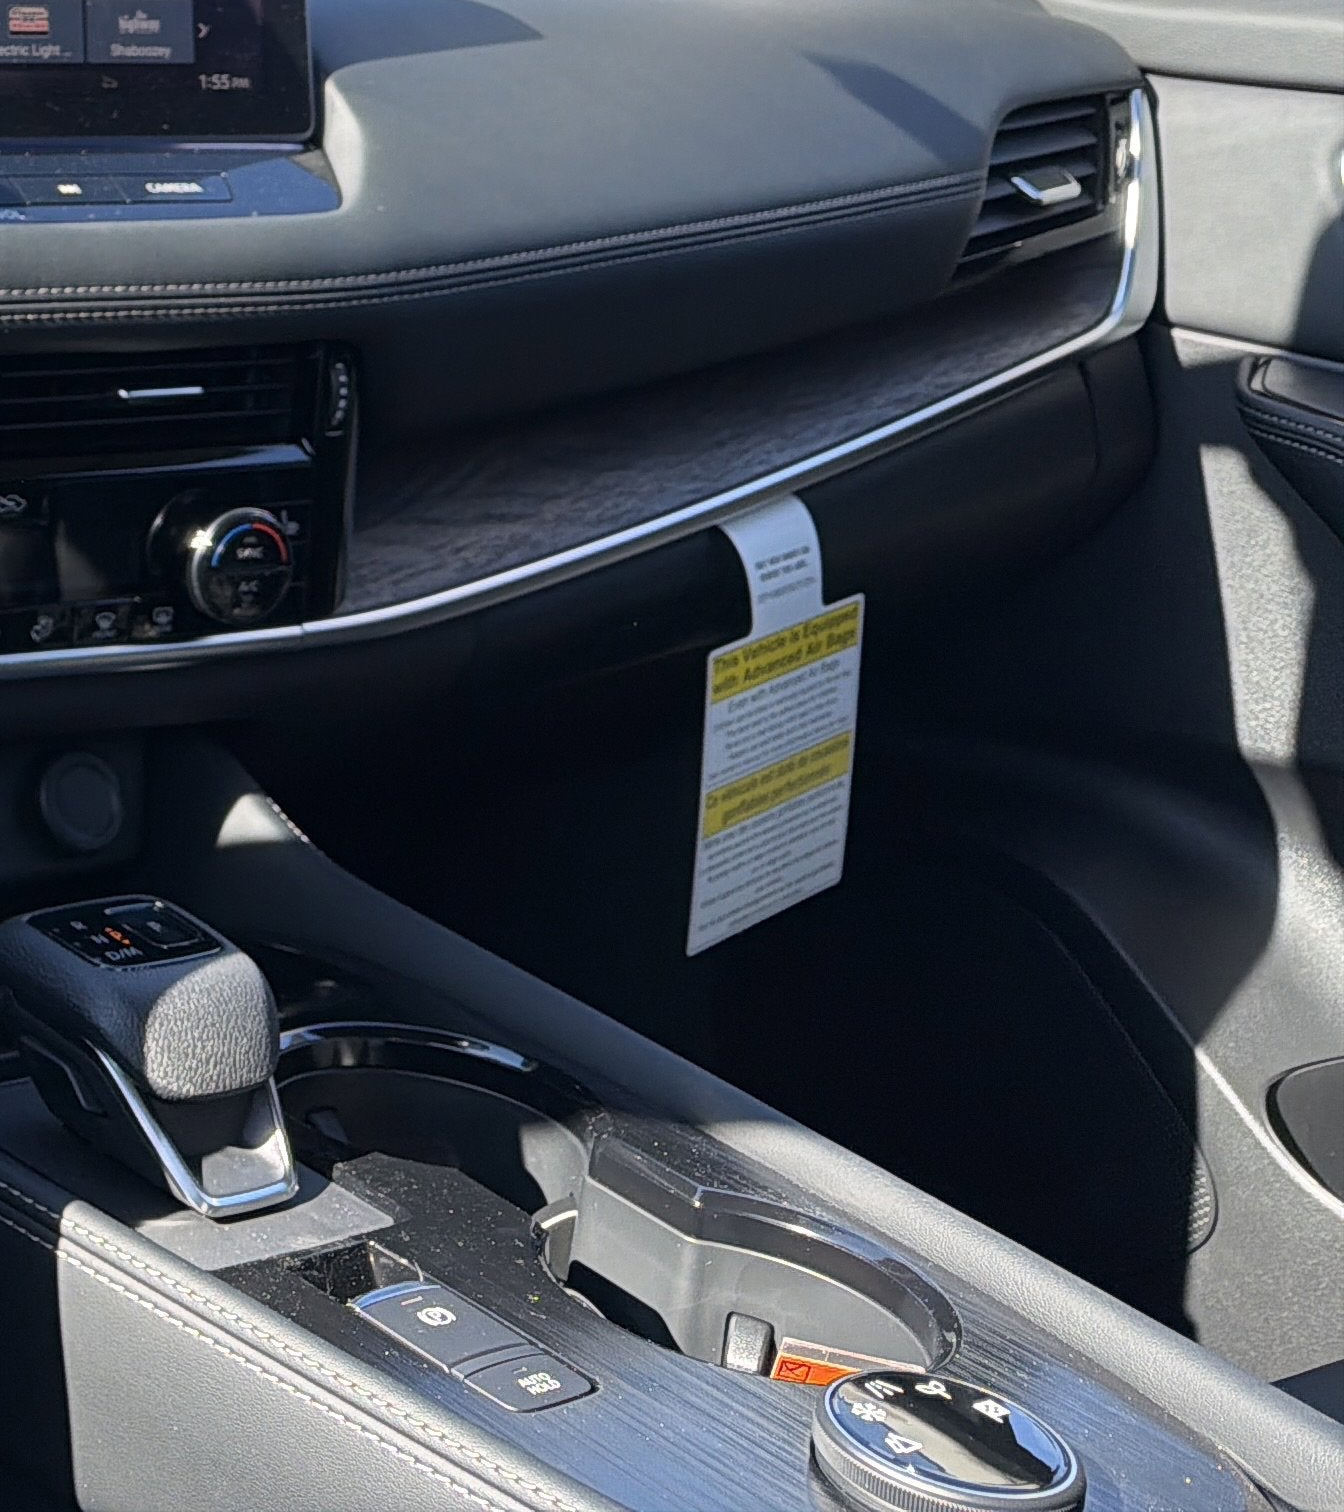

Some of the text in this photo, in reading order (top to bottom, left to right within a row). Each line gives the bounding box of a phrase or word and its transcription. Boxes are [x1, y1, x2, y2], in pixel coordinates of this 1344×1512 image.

[199, 74, 231, 90] 1:55
[517, 1371, 552, 1389] AUTO
[526, 1379, 562, 1396] HOLD
